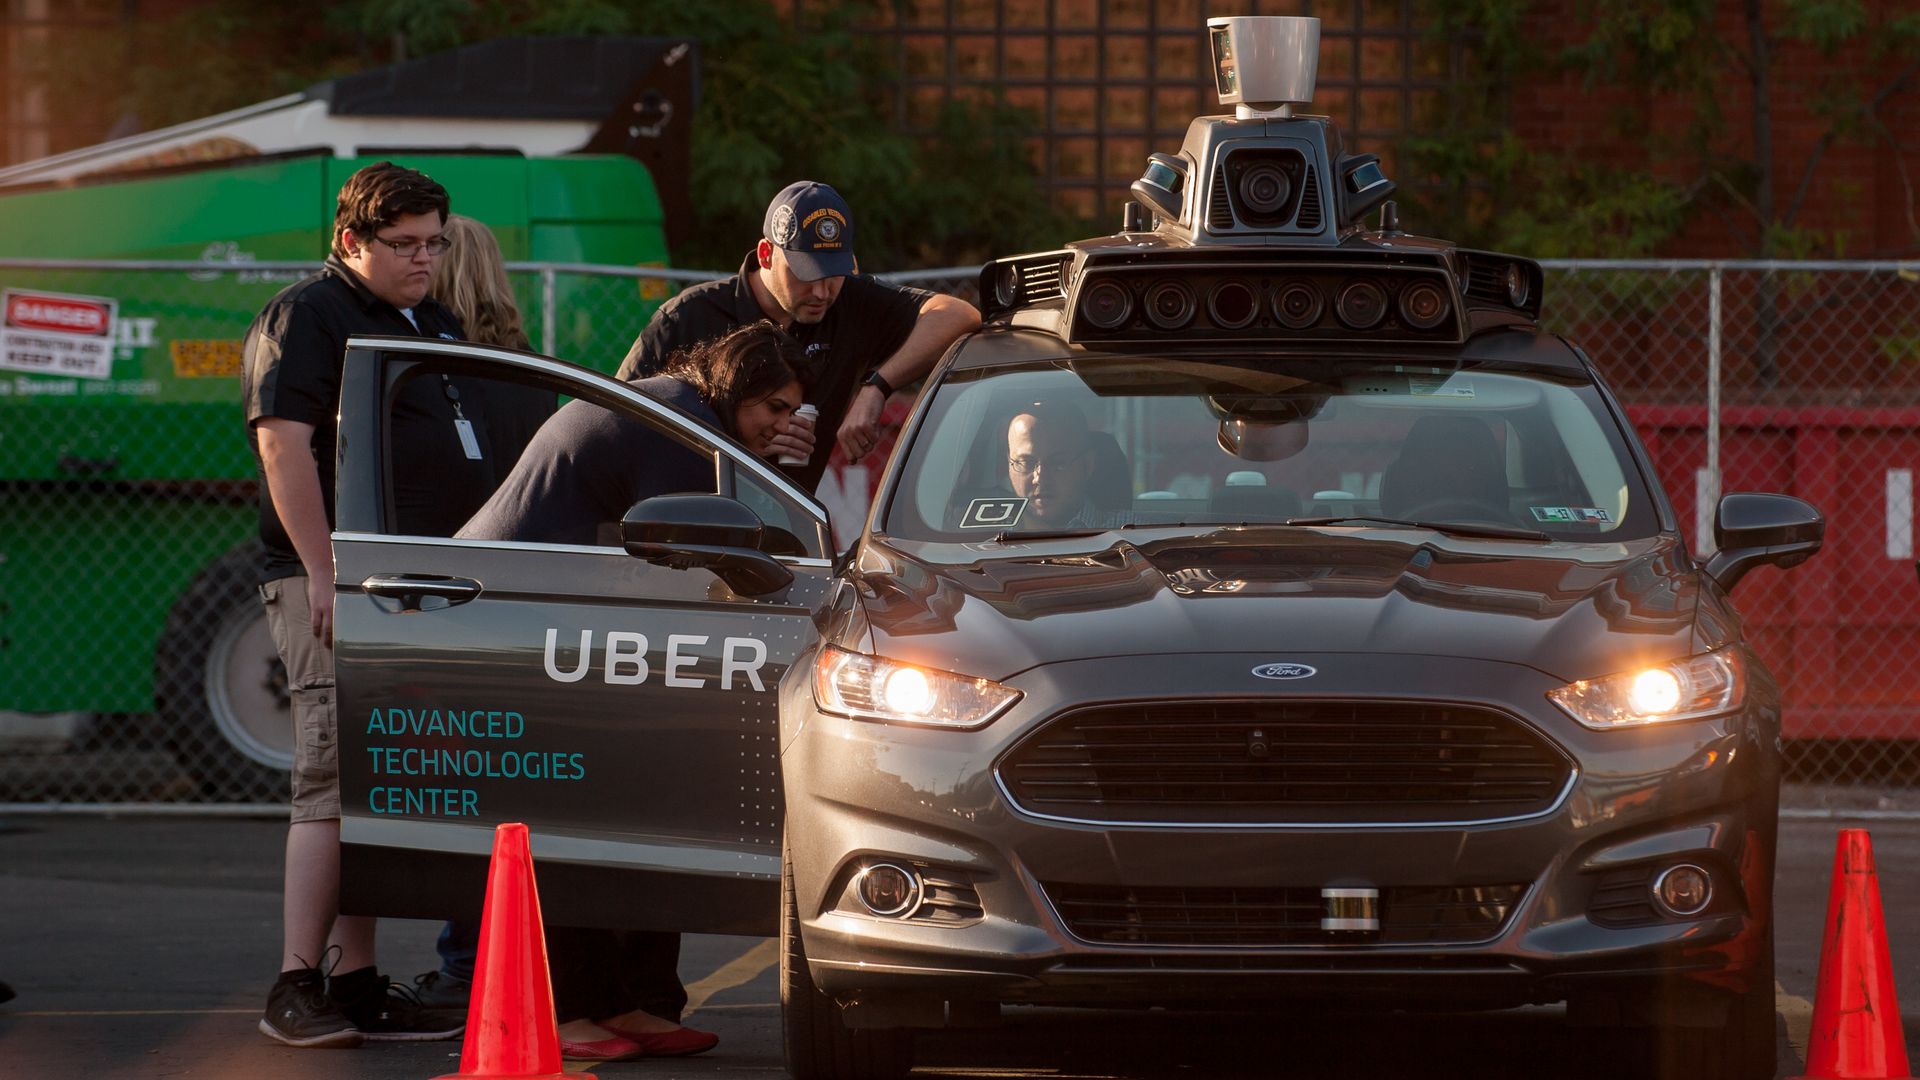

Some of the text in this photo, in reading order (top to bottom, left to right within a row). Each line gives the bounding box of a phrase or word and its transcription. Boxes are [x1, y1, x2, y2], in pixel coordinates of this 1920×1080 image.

[14, 301, 101, 327] DANGER
[7, 351, 97, 369] KEEP OUT
[543, 627, 768, 692] UBER
[1266, 665, 1302, 676] Ford
[366, 707, 525, 739] ADVANCED
[367, 746, 586, 781] TECHNOLOGIES
[369, 786, 480, 817] CENTER
